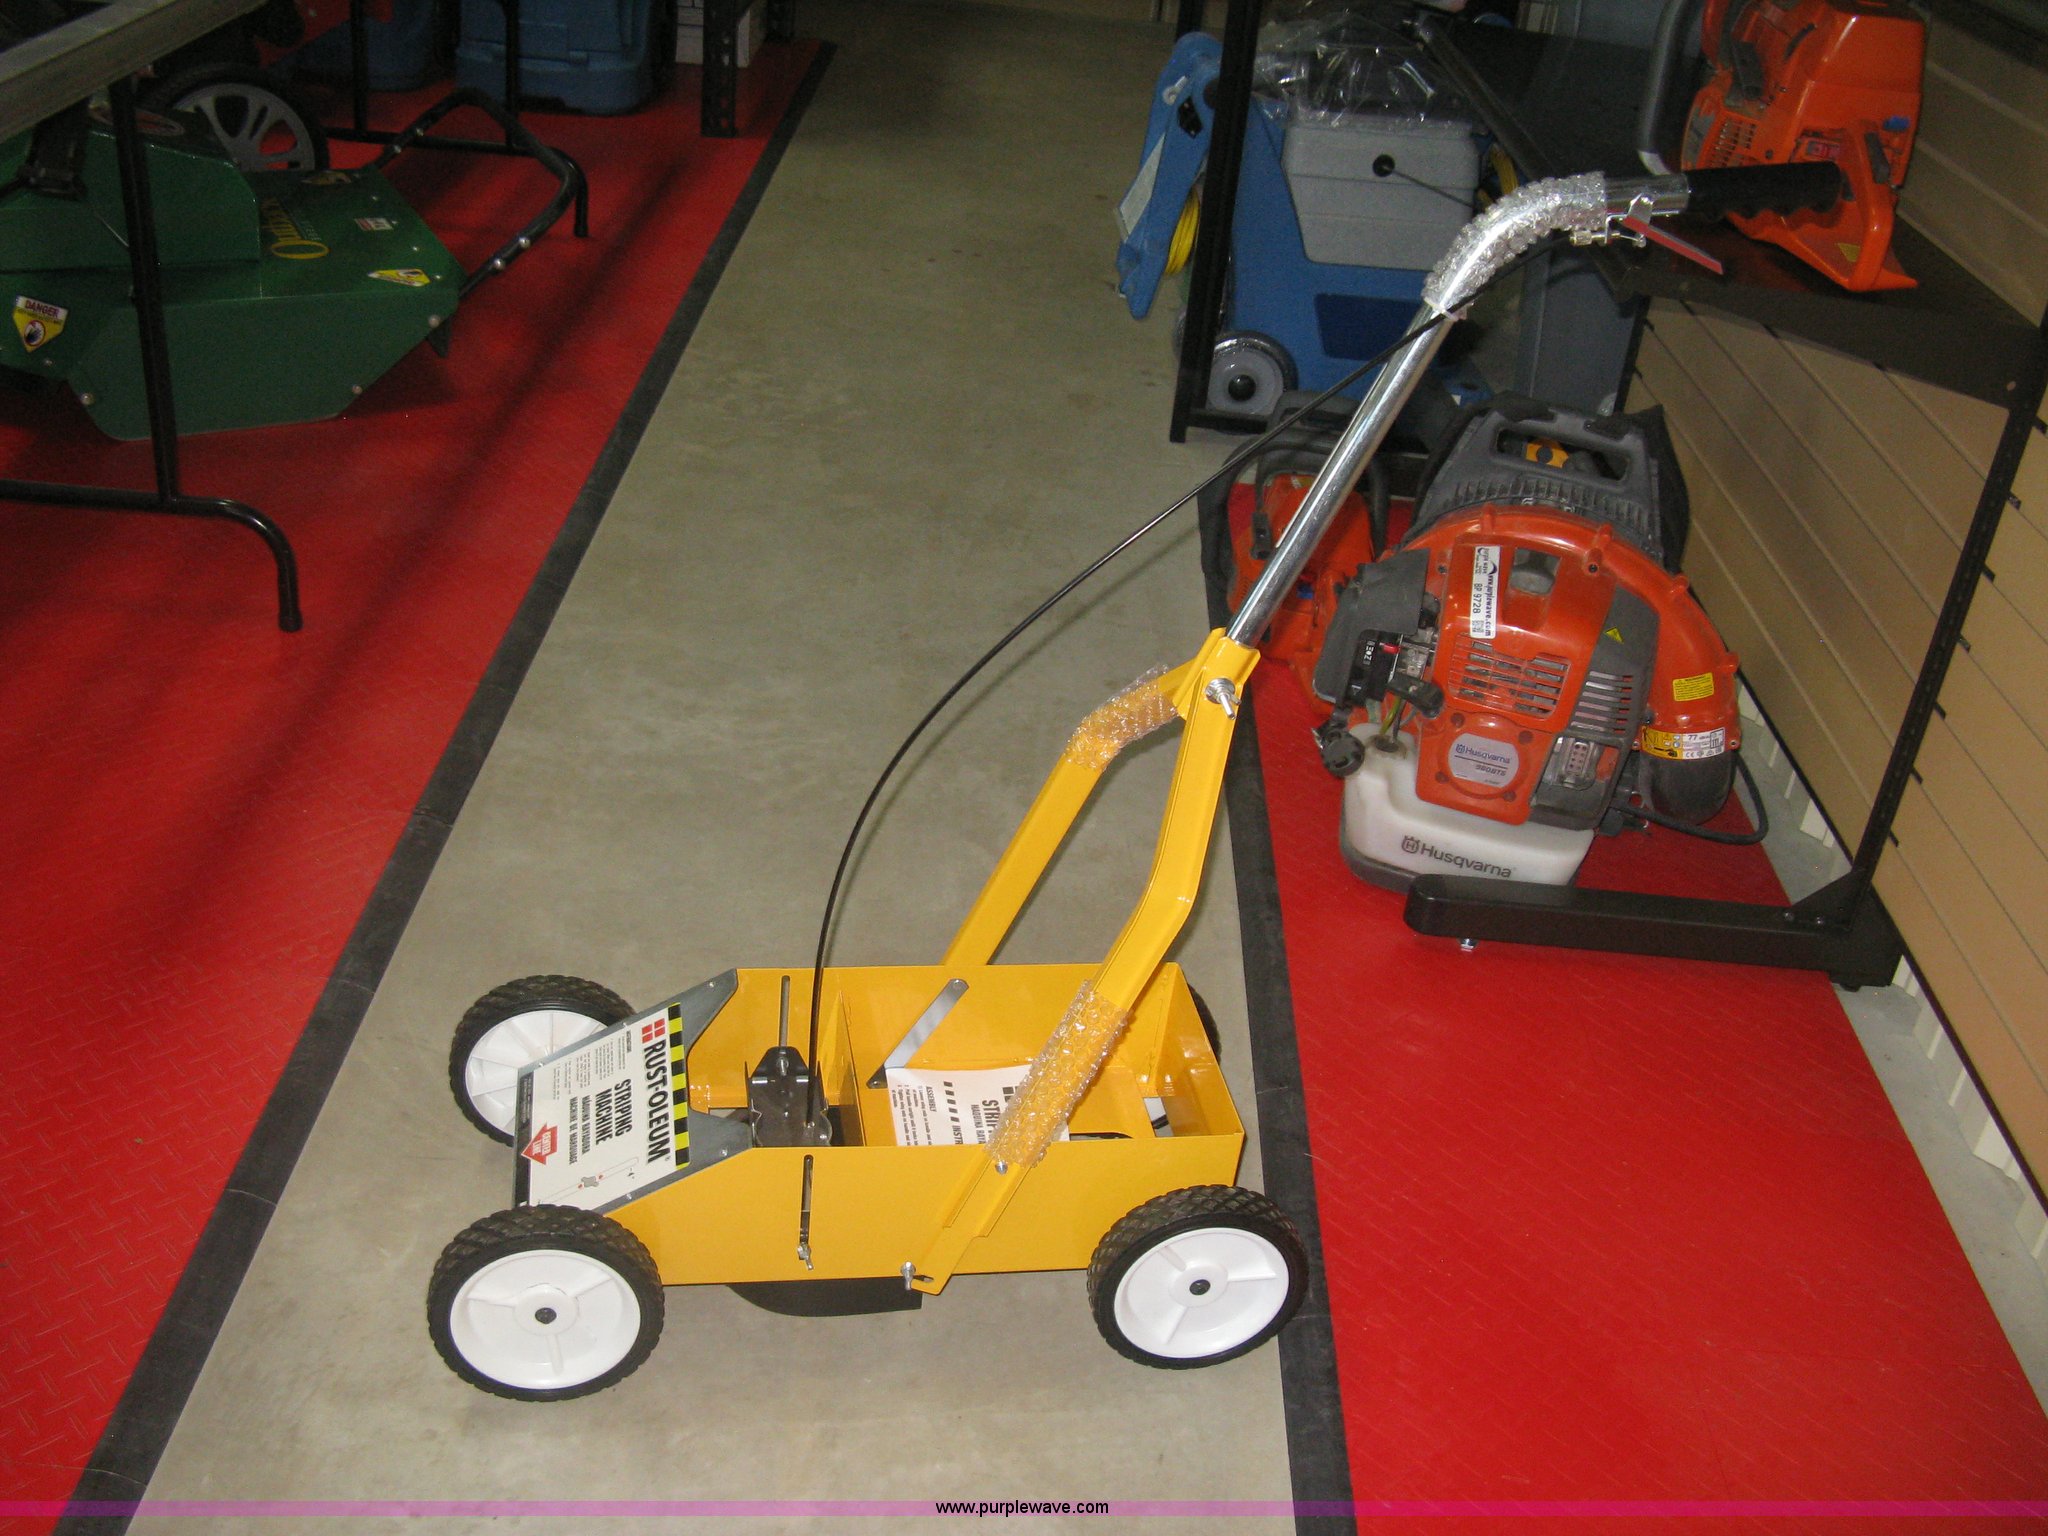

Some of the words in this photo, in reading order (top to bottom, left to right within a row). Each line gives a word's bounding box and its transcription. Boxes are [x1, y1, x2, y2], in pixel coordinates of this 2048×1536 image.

[25, 300, 59, 318] DANGER
[1473, 594, 1482, 614] 9728
[1465, 747, 1510, 764] Husqvarna
[1421, 843, 1512, 878] Husqvarna
[569, 1096, 578, 1123] MACHINE
[614, 1078, 632, 1137] STRIPING
[644, 1039, 671, 1163] RUST-OLEUM
[926, 1086, 937, 1112] ASSEMBLY
[569, 1123, 578, 1132] DE
[595, 1087, 613, 1146] MACHINE
